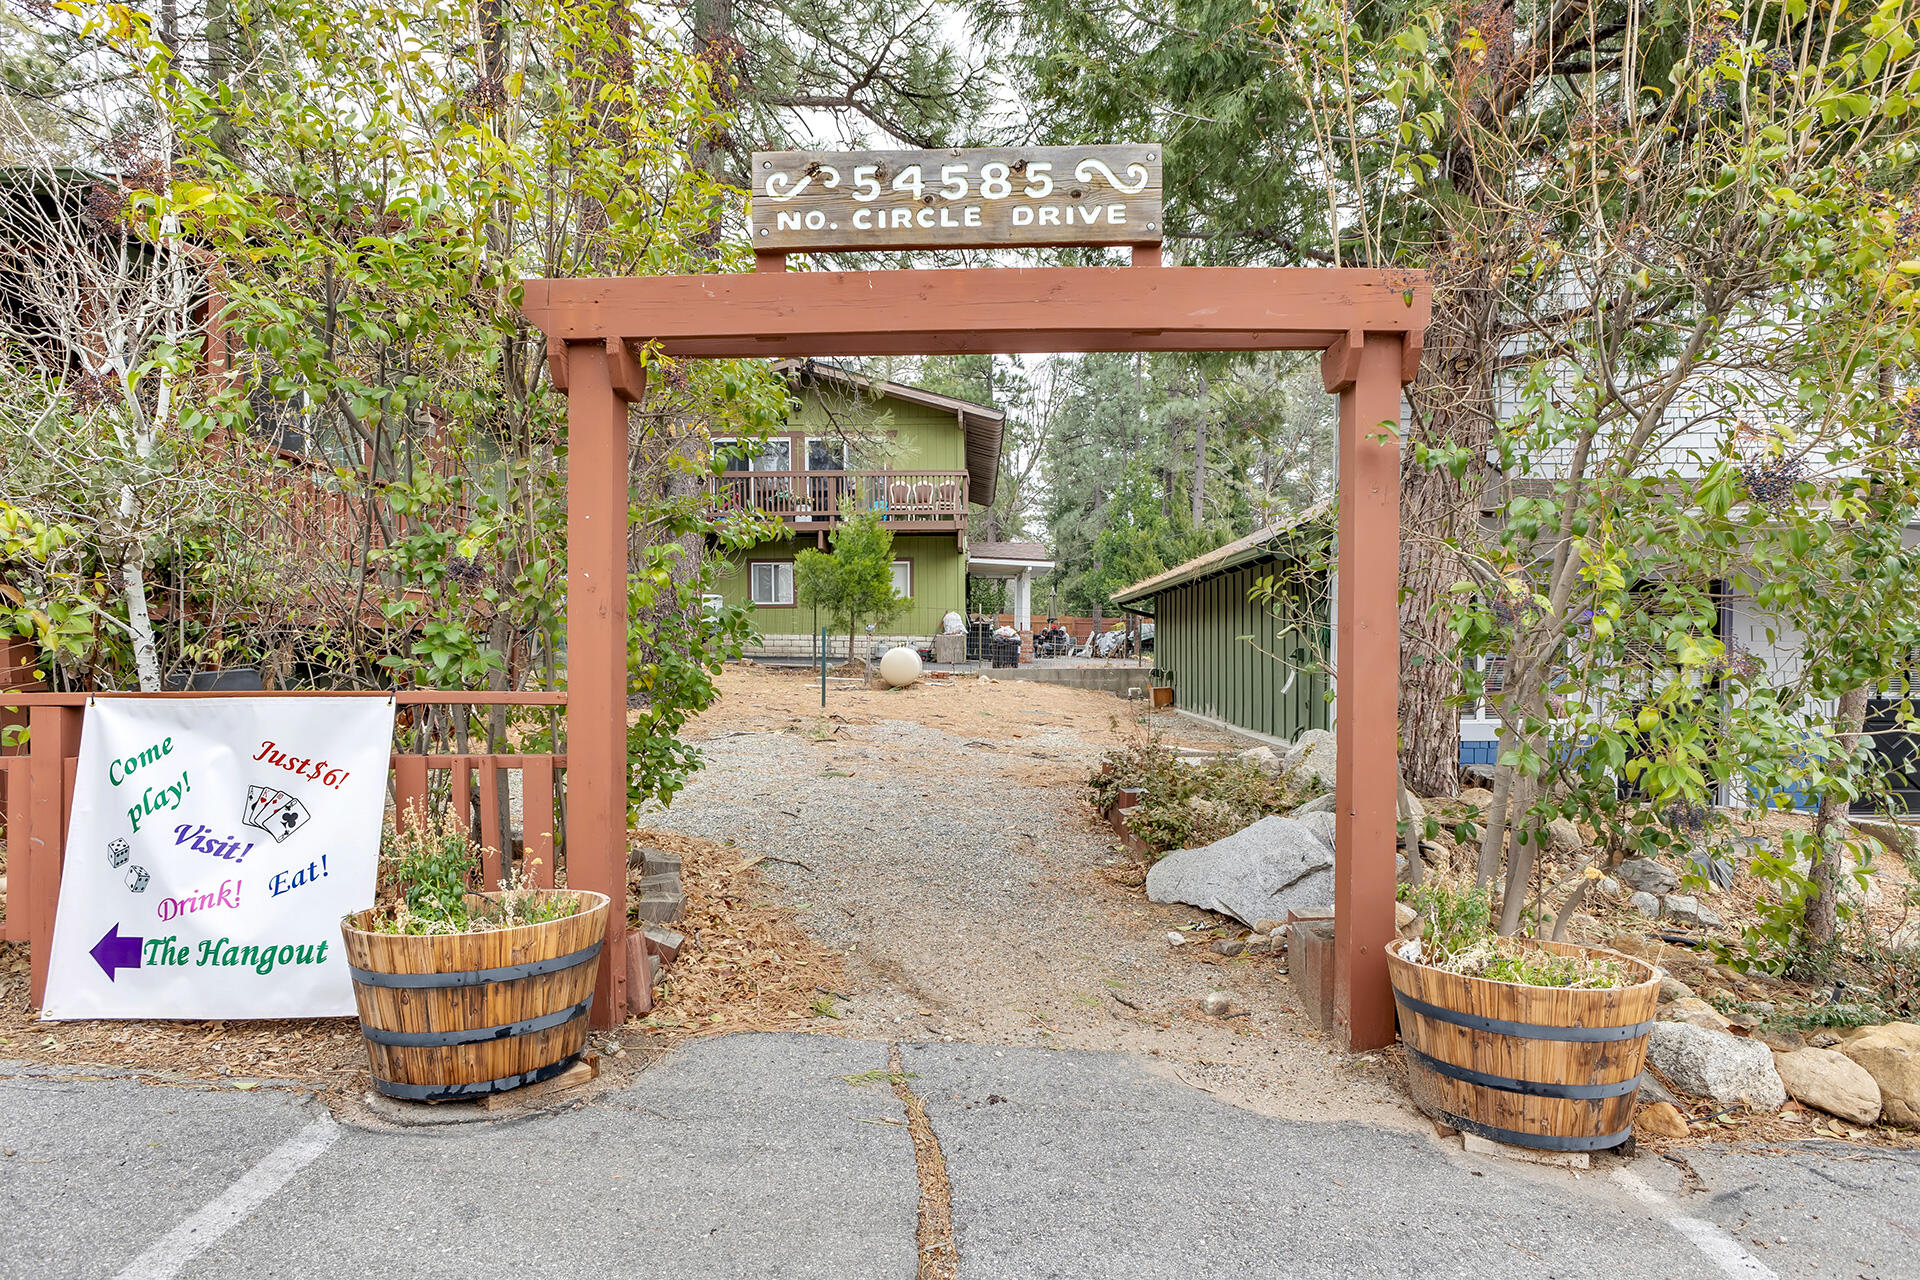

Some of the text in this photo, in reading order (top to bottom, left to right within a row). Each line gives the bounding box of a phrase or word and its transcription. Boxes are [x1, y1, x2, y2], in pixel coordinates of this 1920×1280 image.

[852, 162, 1054, 202] 54585
[776, 203, 1127, 230] NO. CIRCLE DRIVE
[109, 736, 174, 787] Come
[128, 771, 191, 833] play!
[174, 824, 253, 862] Visit!
[269, 855, 328, 898] Eat!
[157, 880, 242, 922] Drink!
[144, 936, 329, 976] The Hangout
